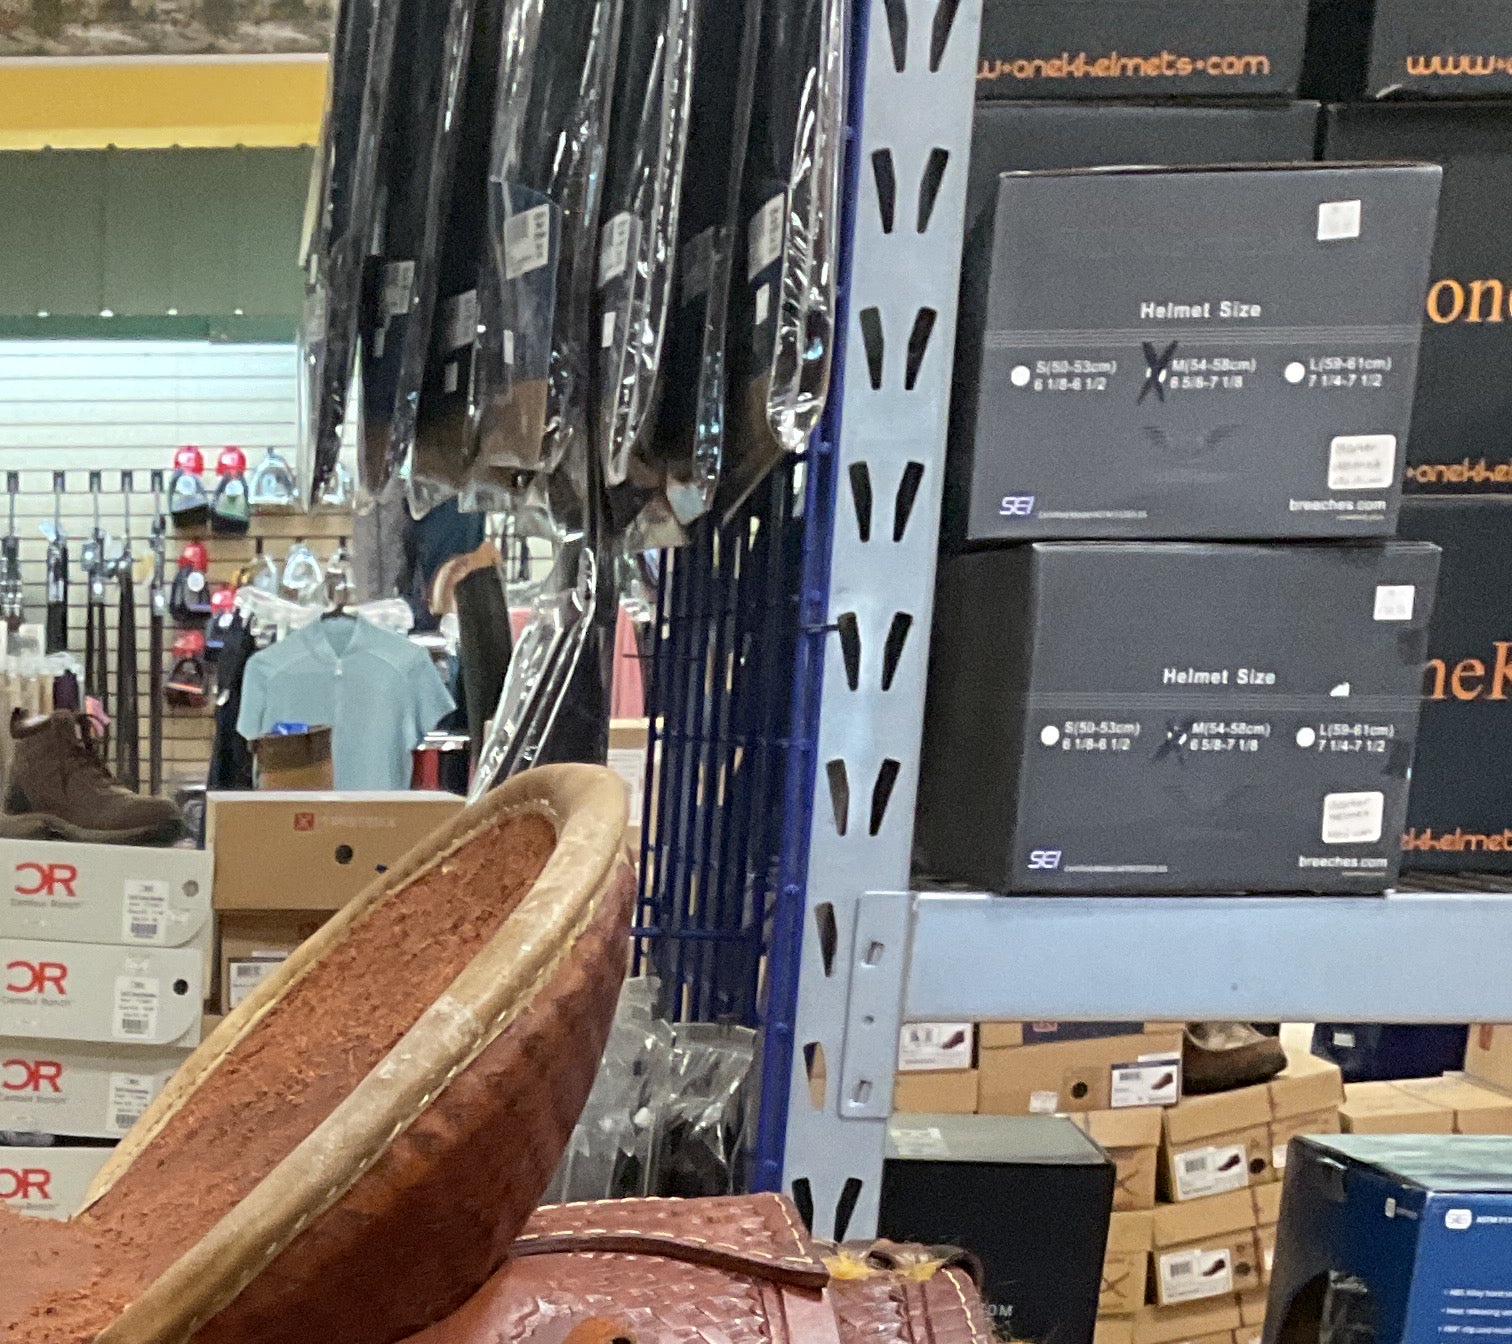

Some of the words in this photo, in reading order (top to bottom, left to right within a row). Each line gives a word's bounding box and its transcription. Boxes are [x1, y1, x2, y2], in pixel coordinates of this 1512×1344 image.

[1140, 301, 1210, 319] Helmet
[1220, 301, 1262, 318] Size
[1425, 278, 1512, 324] on
[1163, 668, 1229, 685] Helmet
[1236, 668, 1276, 685] Size
